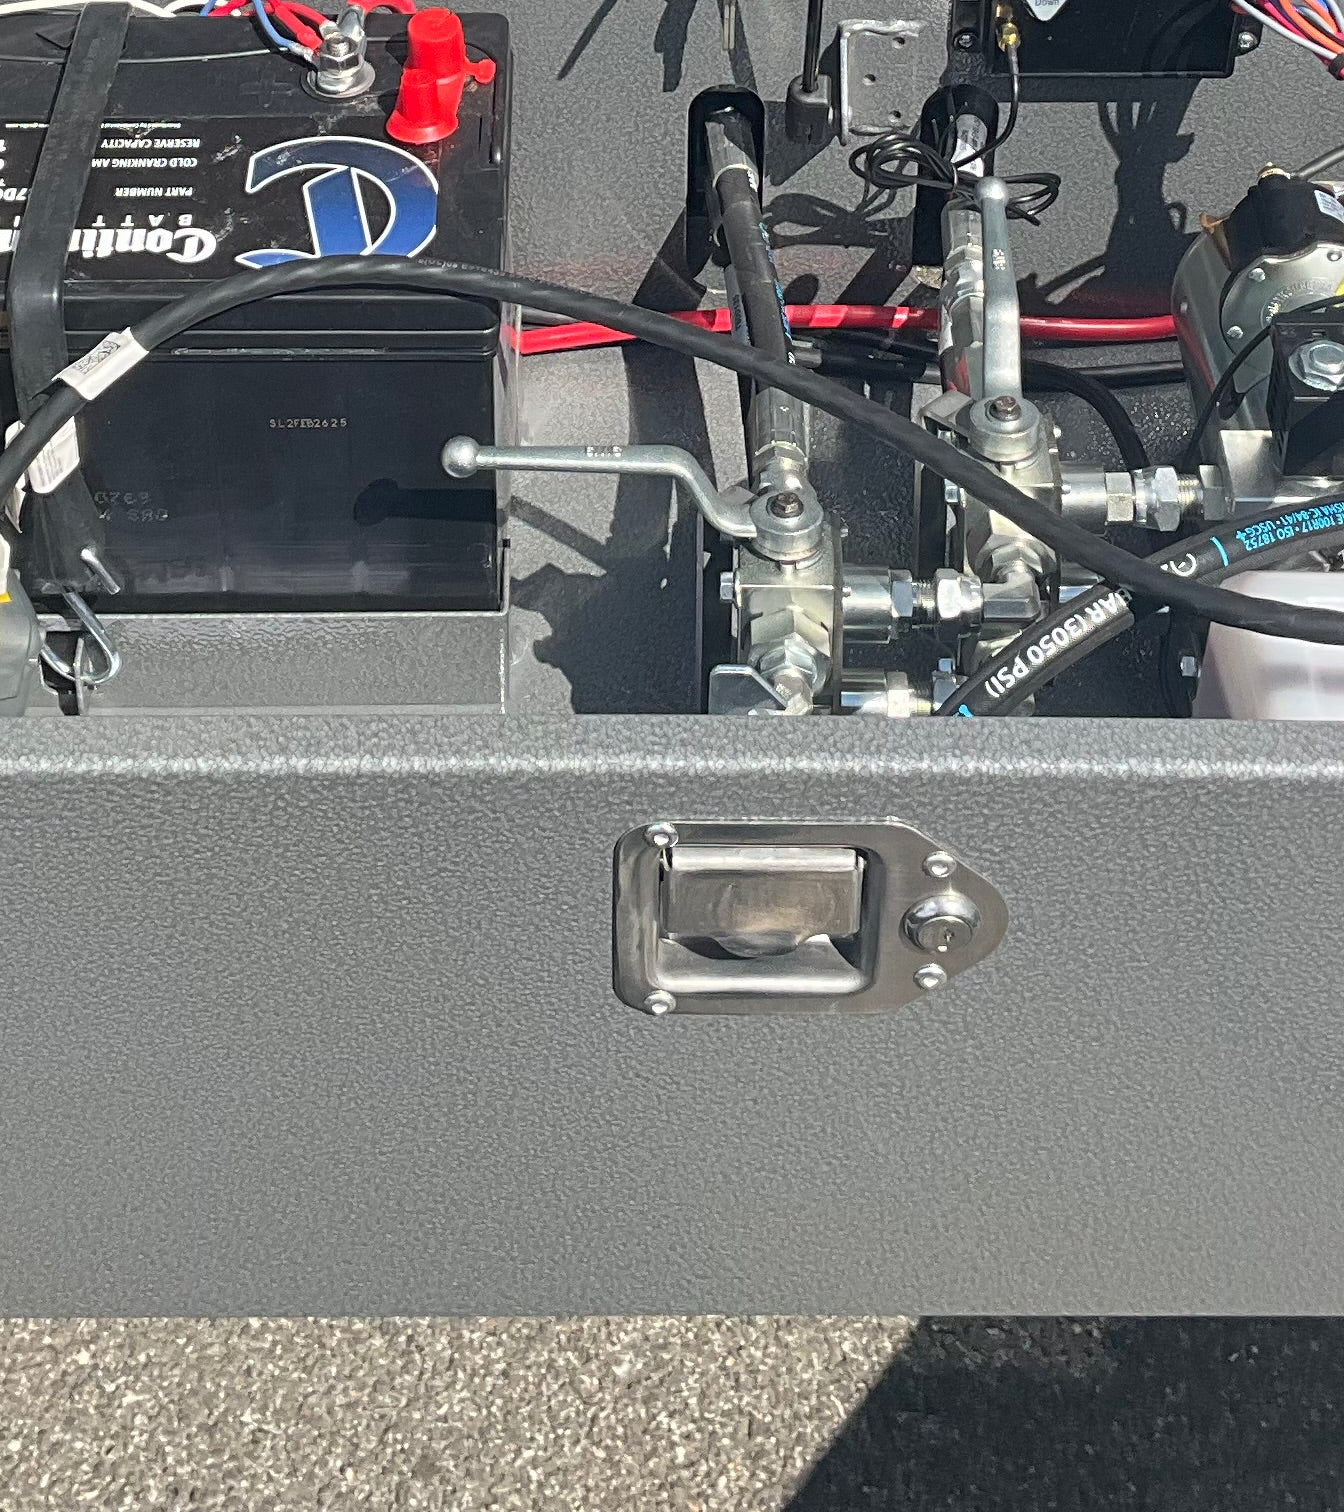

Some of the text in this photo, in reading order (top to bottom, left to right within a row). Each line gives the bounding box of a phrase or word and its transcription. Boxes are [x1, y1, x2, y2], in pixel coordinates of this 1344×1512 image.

[101, 139, 152, 148] CAPACITY
[154, 139, 201, 148] RESERVE
[92, 158, 110, 167] AM
[112, 158, 167, 167] CRANKING
[170, 158, 198, 167] COLD
[115, 187, 163, 196] NUMBER
[166, 187, 193, 196] PART
[1245, 520, 1277, 538] USCG
[1302, 517, 1337, 533] 100R17
[1277, 526, 1295, 539] ISO
[1244, 532, 1276, 551] 18752
[1026, 613, 1089, 665] (3050
[984, 655, 1030, 698] PSI)
